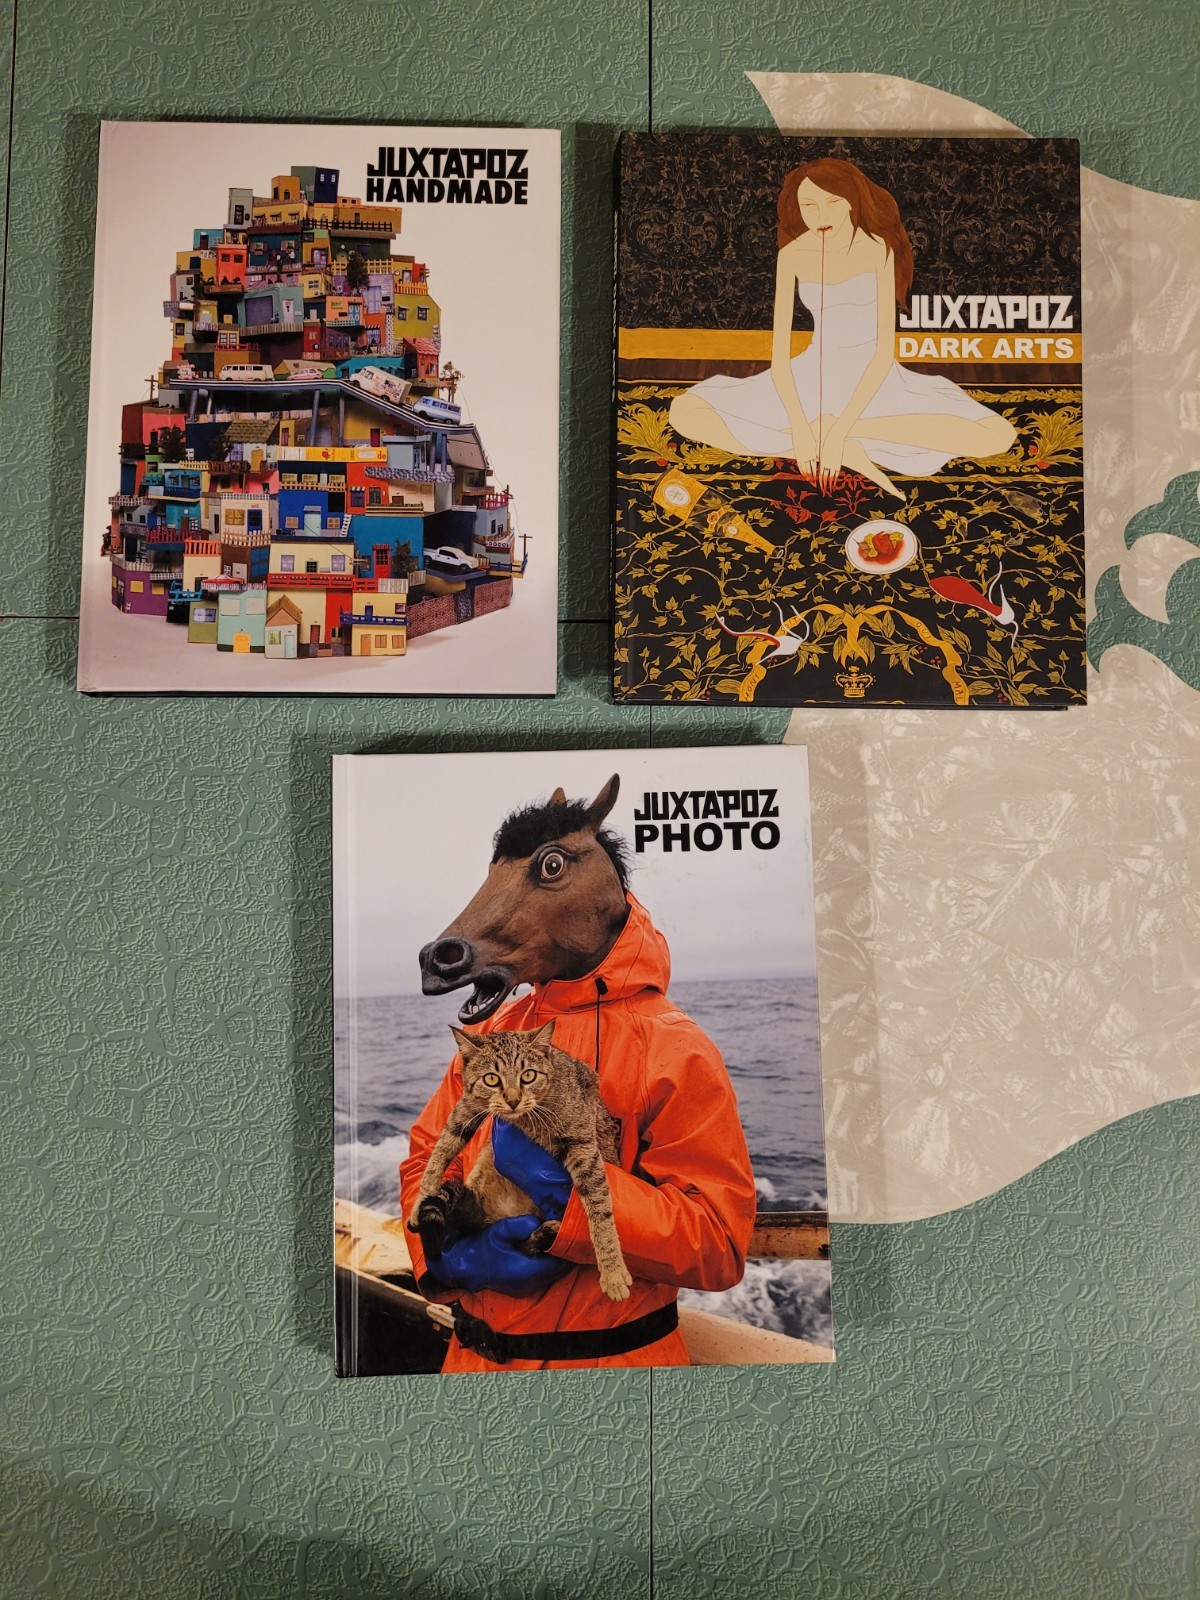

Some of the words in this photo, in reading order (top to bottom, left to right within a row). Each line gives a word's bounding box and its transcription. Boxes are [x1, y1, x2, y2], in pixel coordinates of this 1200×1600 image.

[367, 147, 529, 179] JUXTAPOZ
[366, 178, 528, 205] HANDMADE
[899, 295, 1073, 329] JUXTAPOZ
[899, 337, 983, 359] DARK
[991, 337, 1074, 359] ARTS
[634, 789, 779, 821] JUXTAPOZ
[635, 821, 781, 853] PHOTO
